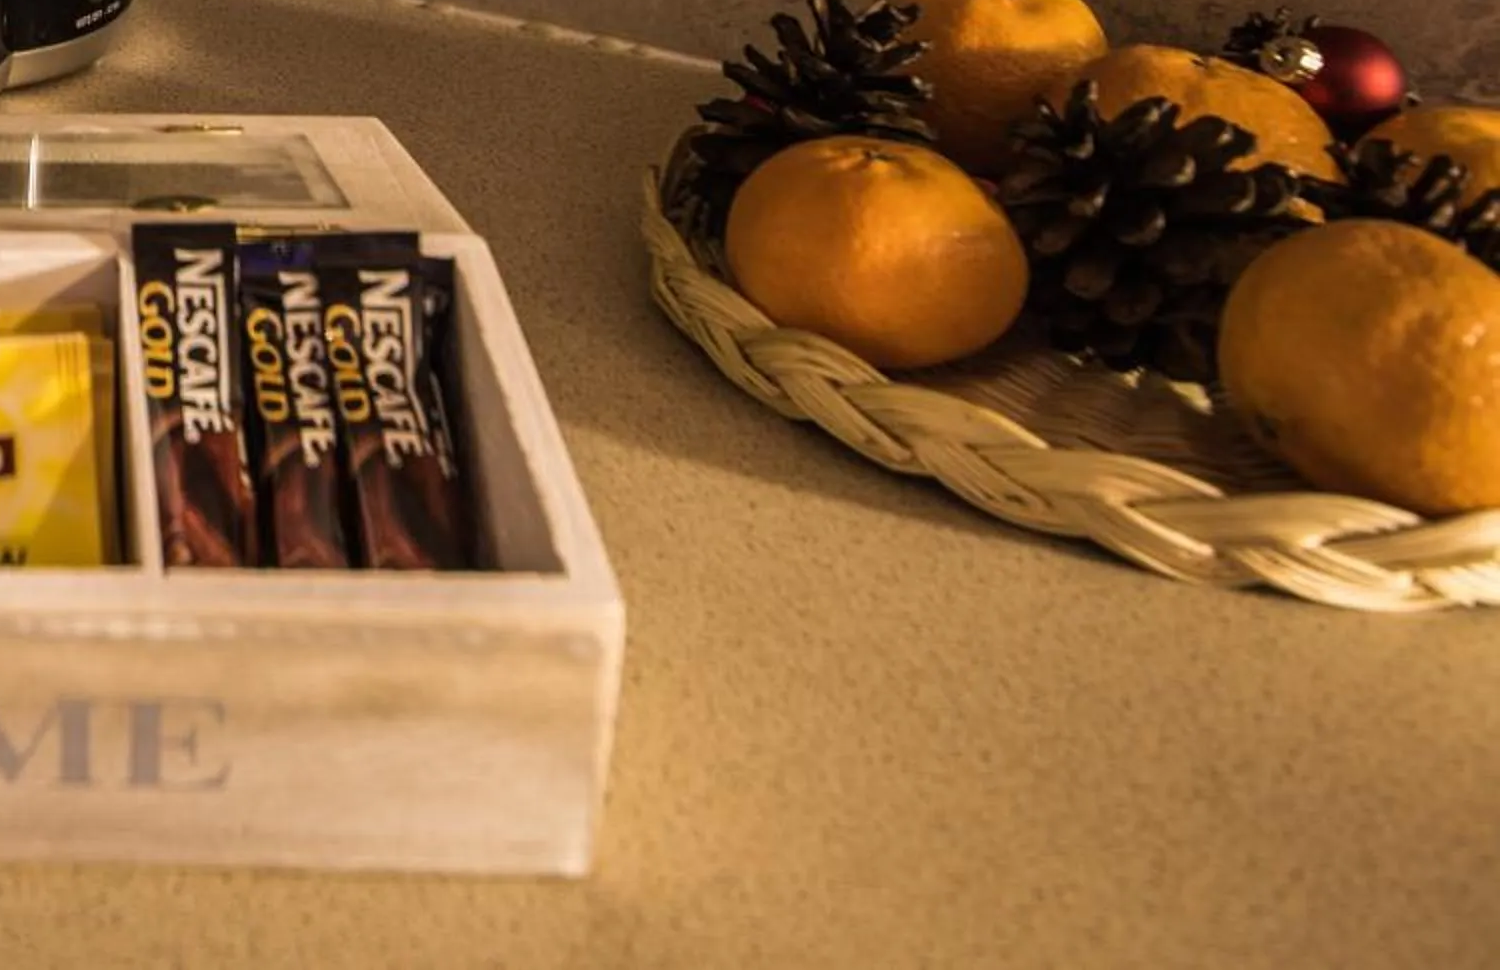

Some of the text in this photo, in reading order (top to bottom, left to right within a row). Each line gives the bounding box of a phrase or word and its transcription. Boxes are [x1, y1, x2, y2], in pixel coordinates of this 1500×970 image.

[138, 280, 176, 399] GOLD
[246, 307, 290, 423] GOLD
[323, 303, 371, 422] GOLD
